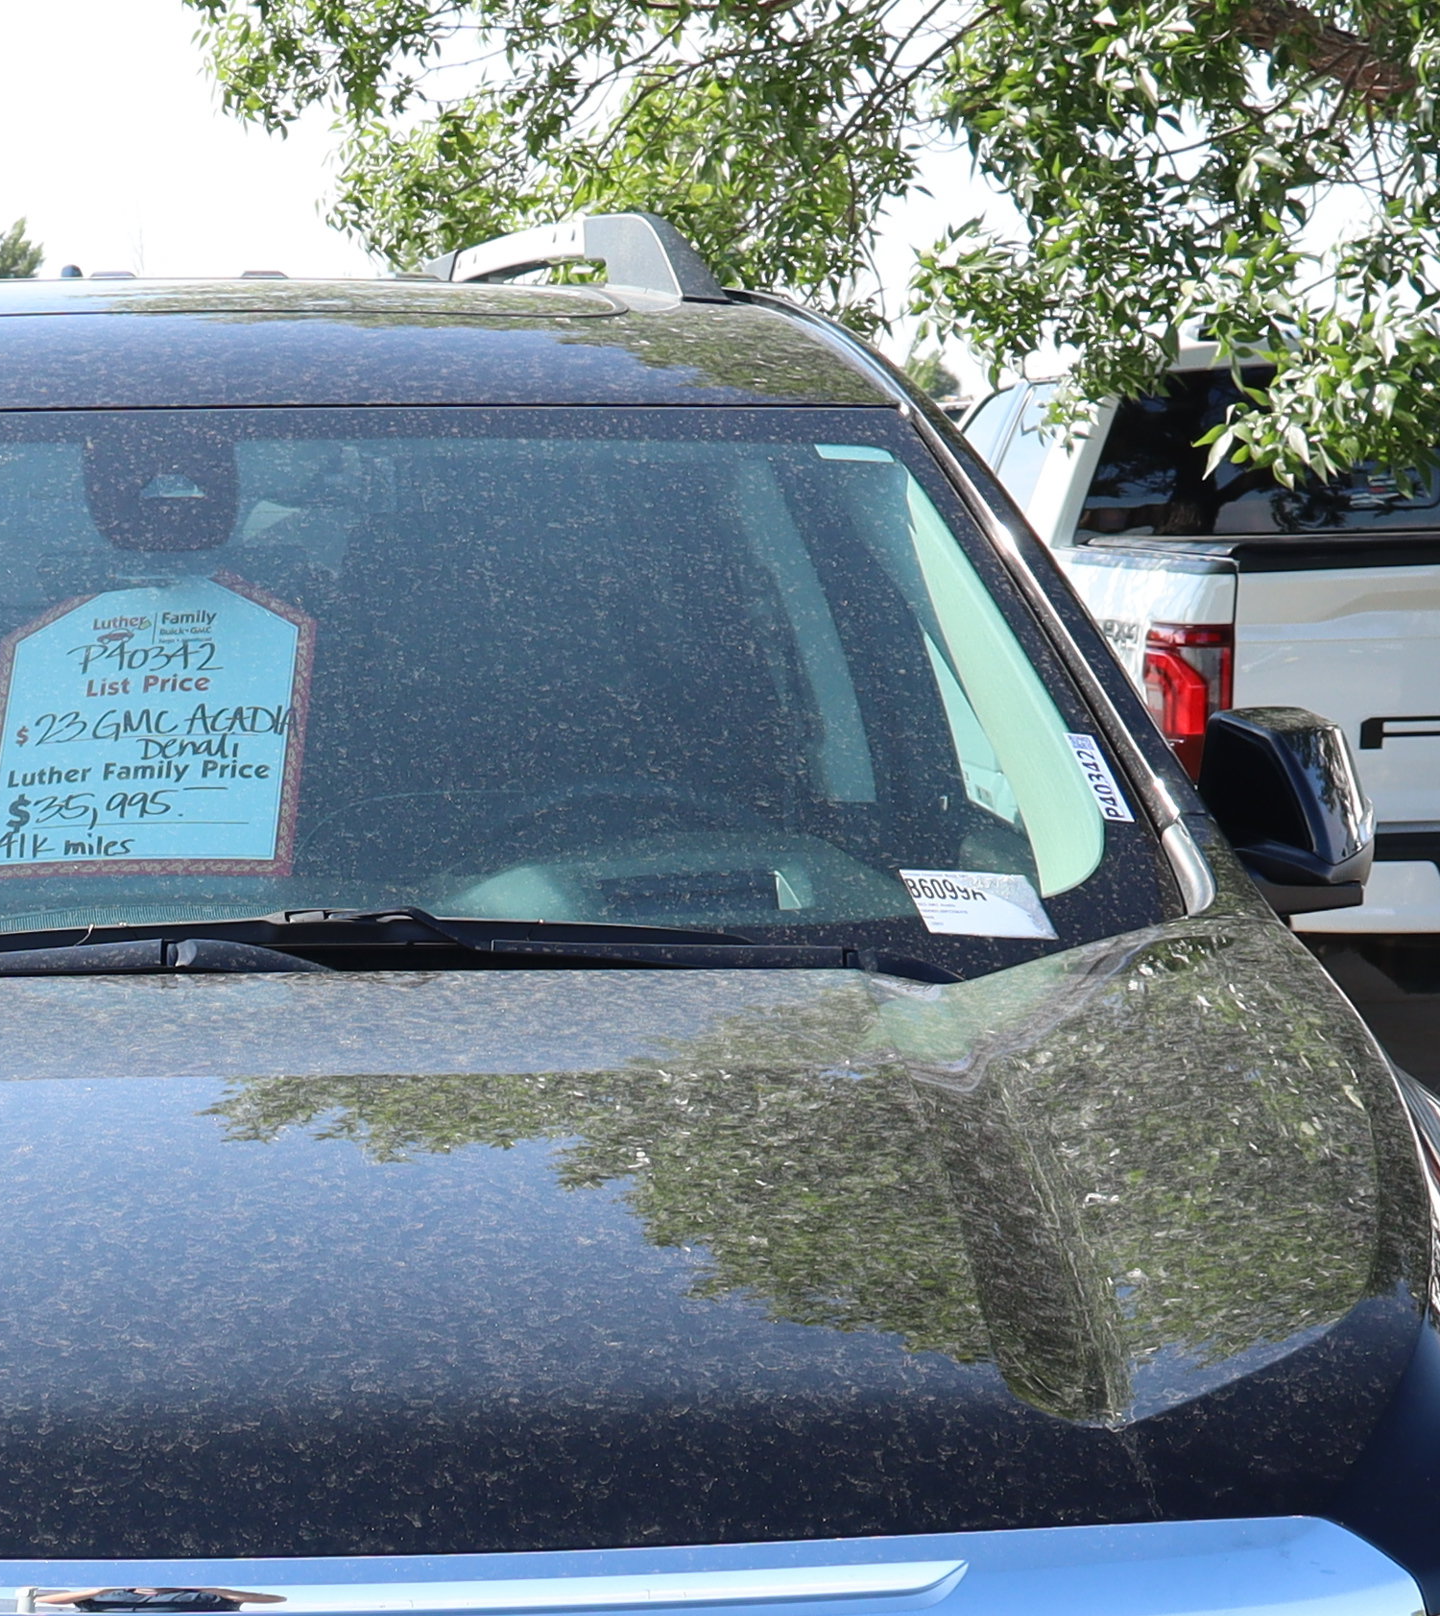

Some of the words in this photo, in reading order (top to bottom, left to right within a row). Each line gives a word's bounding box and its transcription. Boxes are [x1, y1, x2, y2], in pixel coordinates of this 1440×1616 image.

[92, 616, 148, 630] Luther
[161, 610, 217, 626] Family
[67, 642, 224, 674] P40342
[86, 677, 131, 697] List
[143, 674, 211, 693] Price
[92, 709, 179, 741] GMC
[184, 703, 299, 740] ACADIA
[136, 733, 240, 761] Denali
[7, 766, 93, 788] Luther
[102, 760, 190, 782] Family
[201, 759, 270, 780] Price
[1076, 749, 1125, 818] P40342
[63, 833, 136, 856] miles
